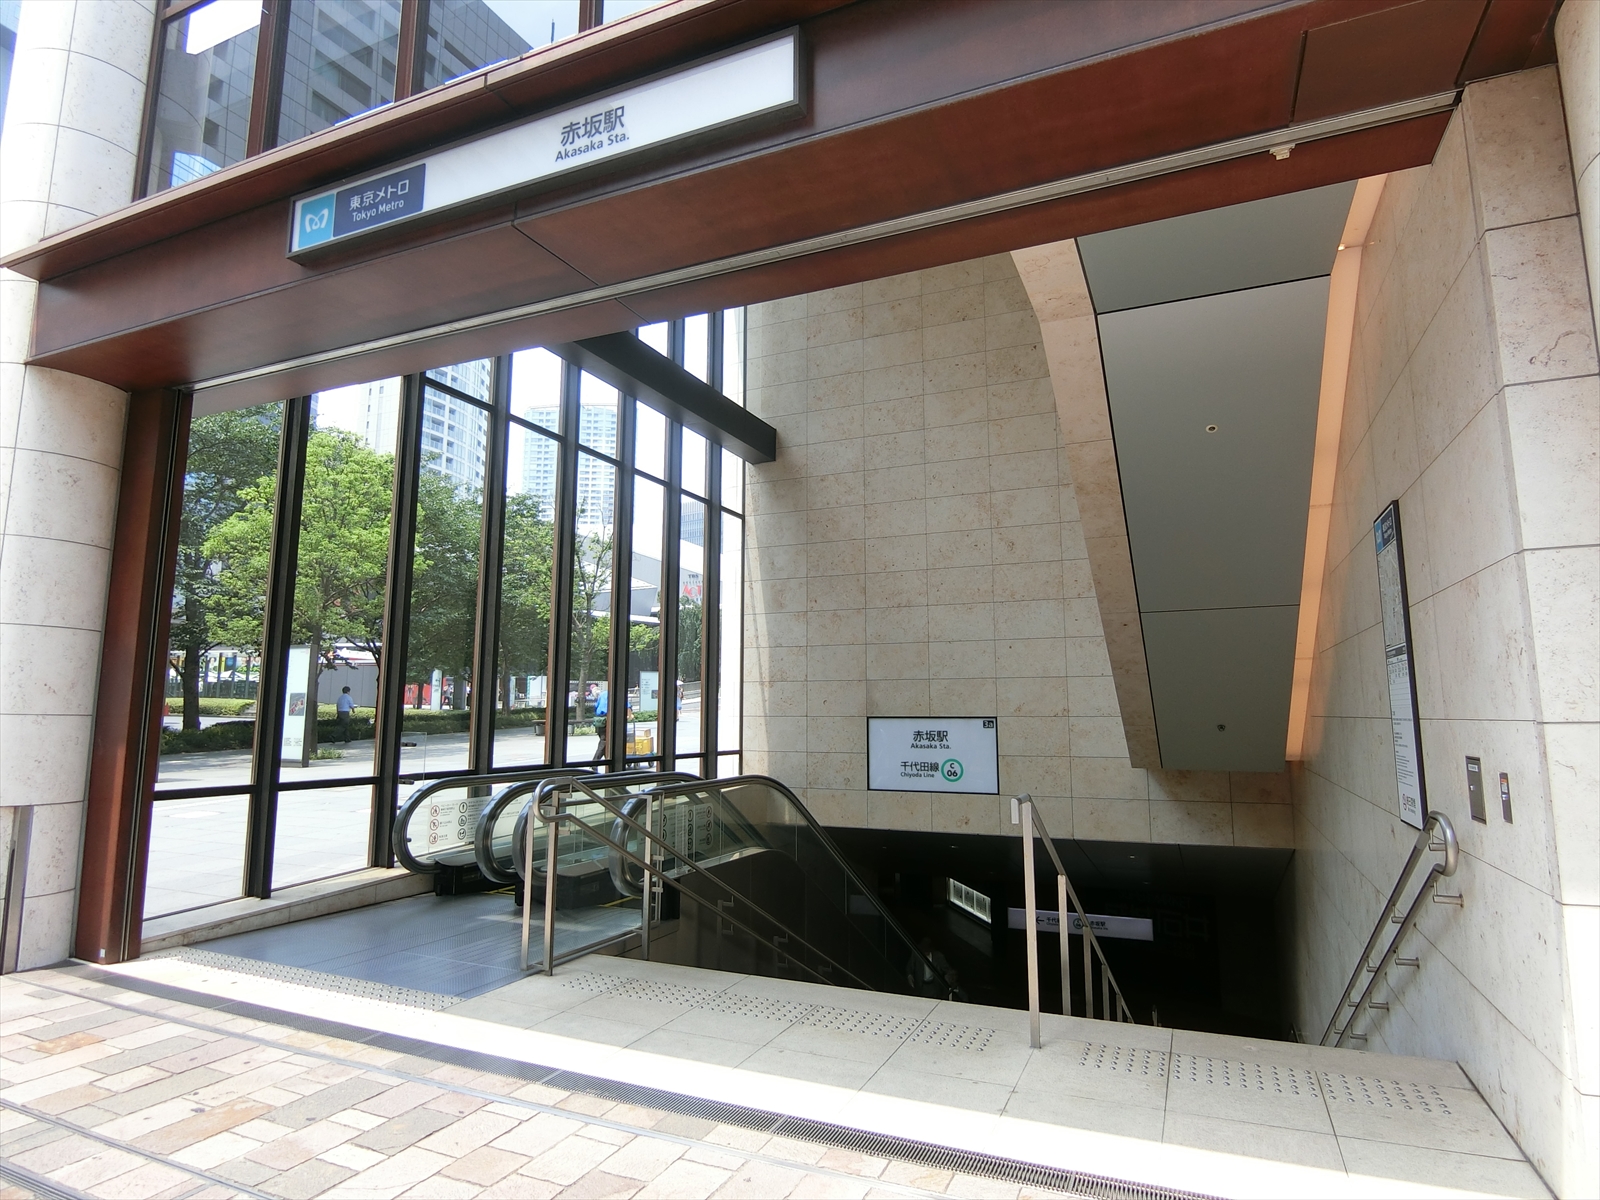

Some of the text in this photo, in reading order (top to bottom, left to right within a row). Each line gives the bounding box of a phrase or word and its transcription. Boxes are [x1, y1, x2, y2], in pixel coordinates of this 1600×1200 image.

[560, 105, 626, 147] 赤坂駅
[555, 133, 631, 163] Akasaka Sta.
[349, 179, 410, 211] 東京メトロ
[352, 199, 405, 223] Tokyo Metro
[913, 730, 949, 742] 赤坂駅
[984, 720, 994, 728] 3a
[900, 761, 940, 772] 千代田線
